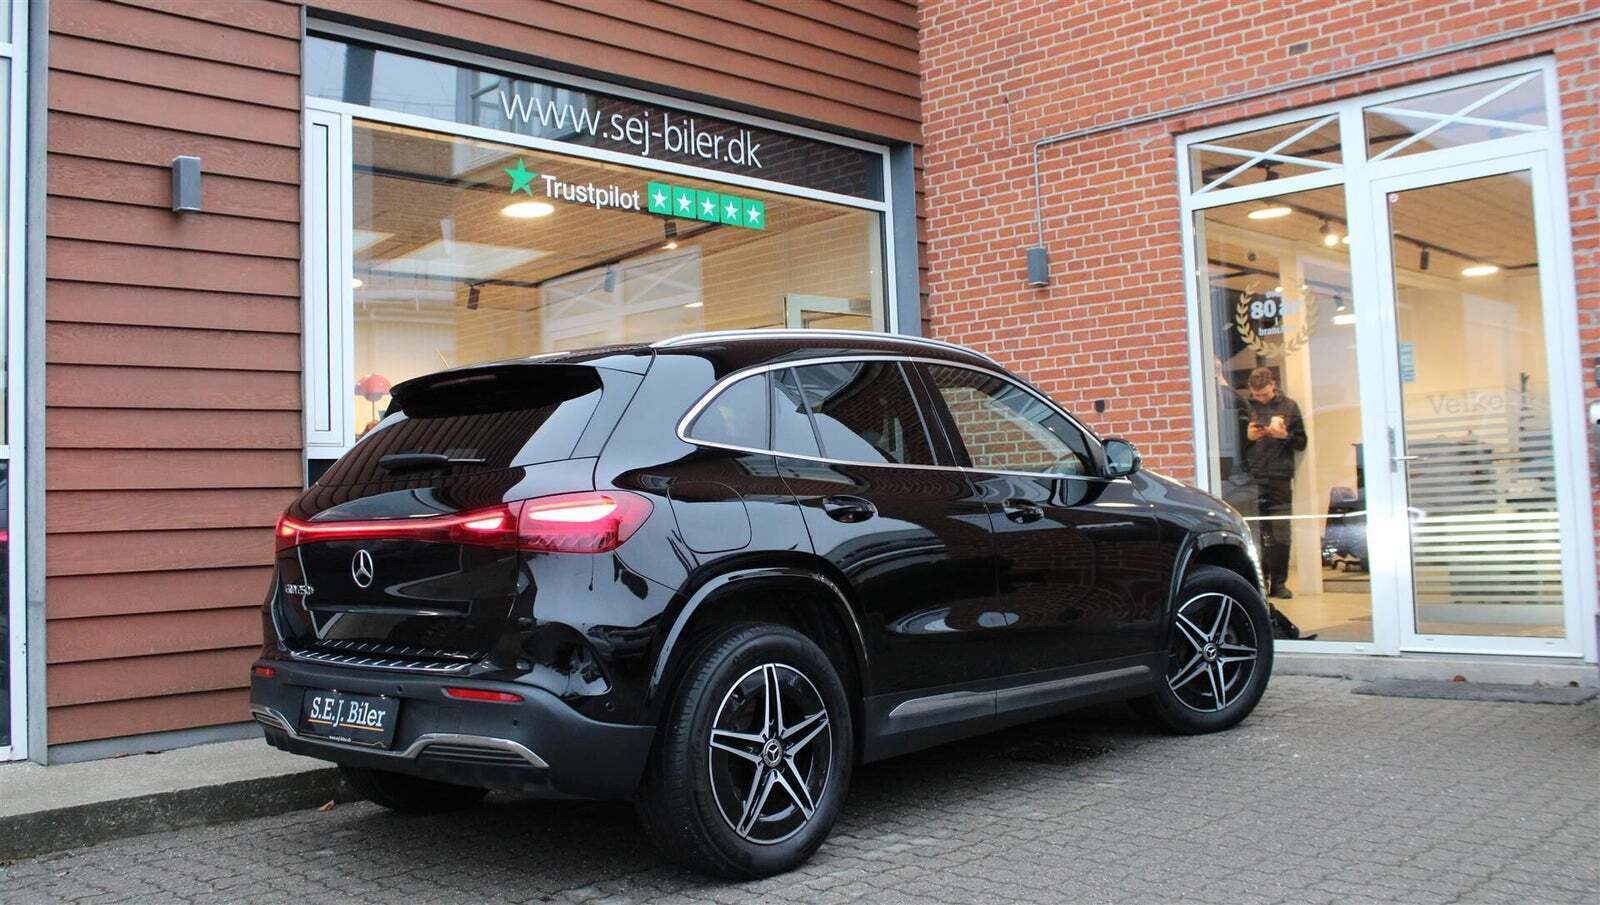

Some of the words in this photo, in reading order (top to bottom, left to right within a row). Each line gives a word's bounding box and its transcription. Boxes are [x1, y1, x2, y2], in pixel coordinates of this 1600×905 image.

[500, 90, 763, 169] www.sej-biler.dk
[541, 174, 641, 211] Trustpilot
[1250, 299, 1277, 319] 80
[310, 696, 344, 727] S.E.J.
[346, 701, 386, 727] Biler
